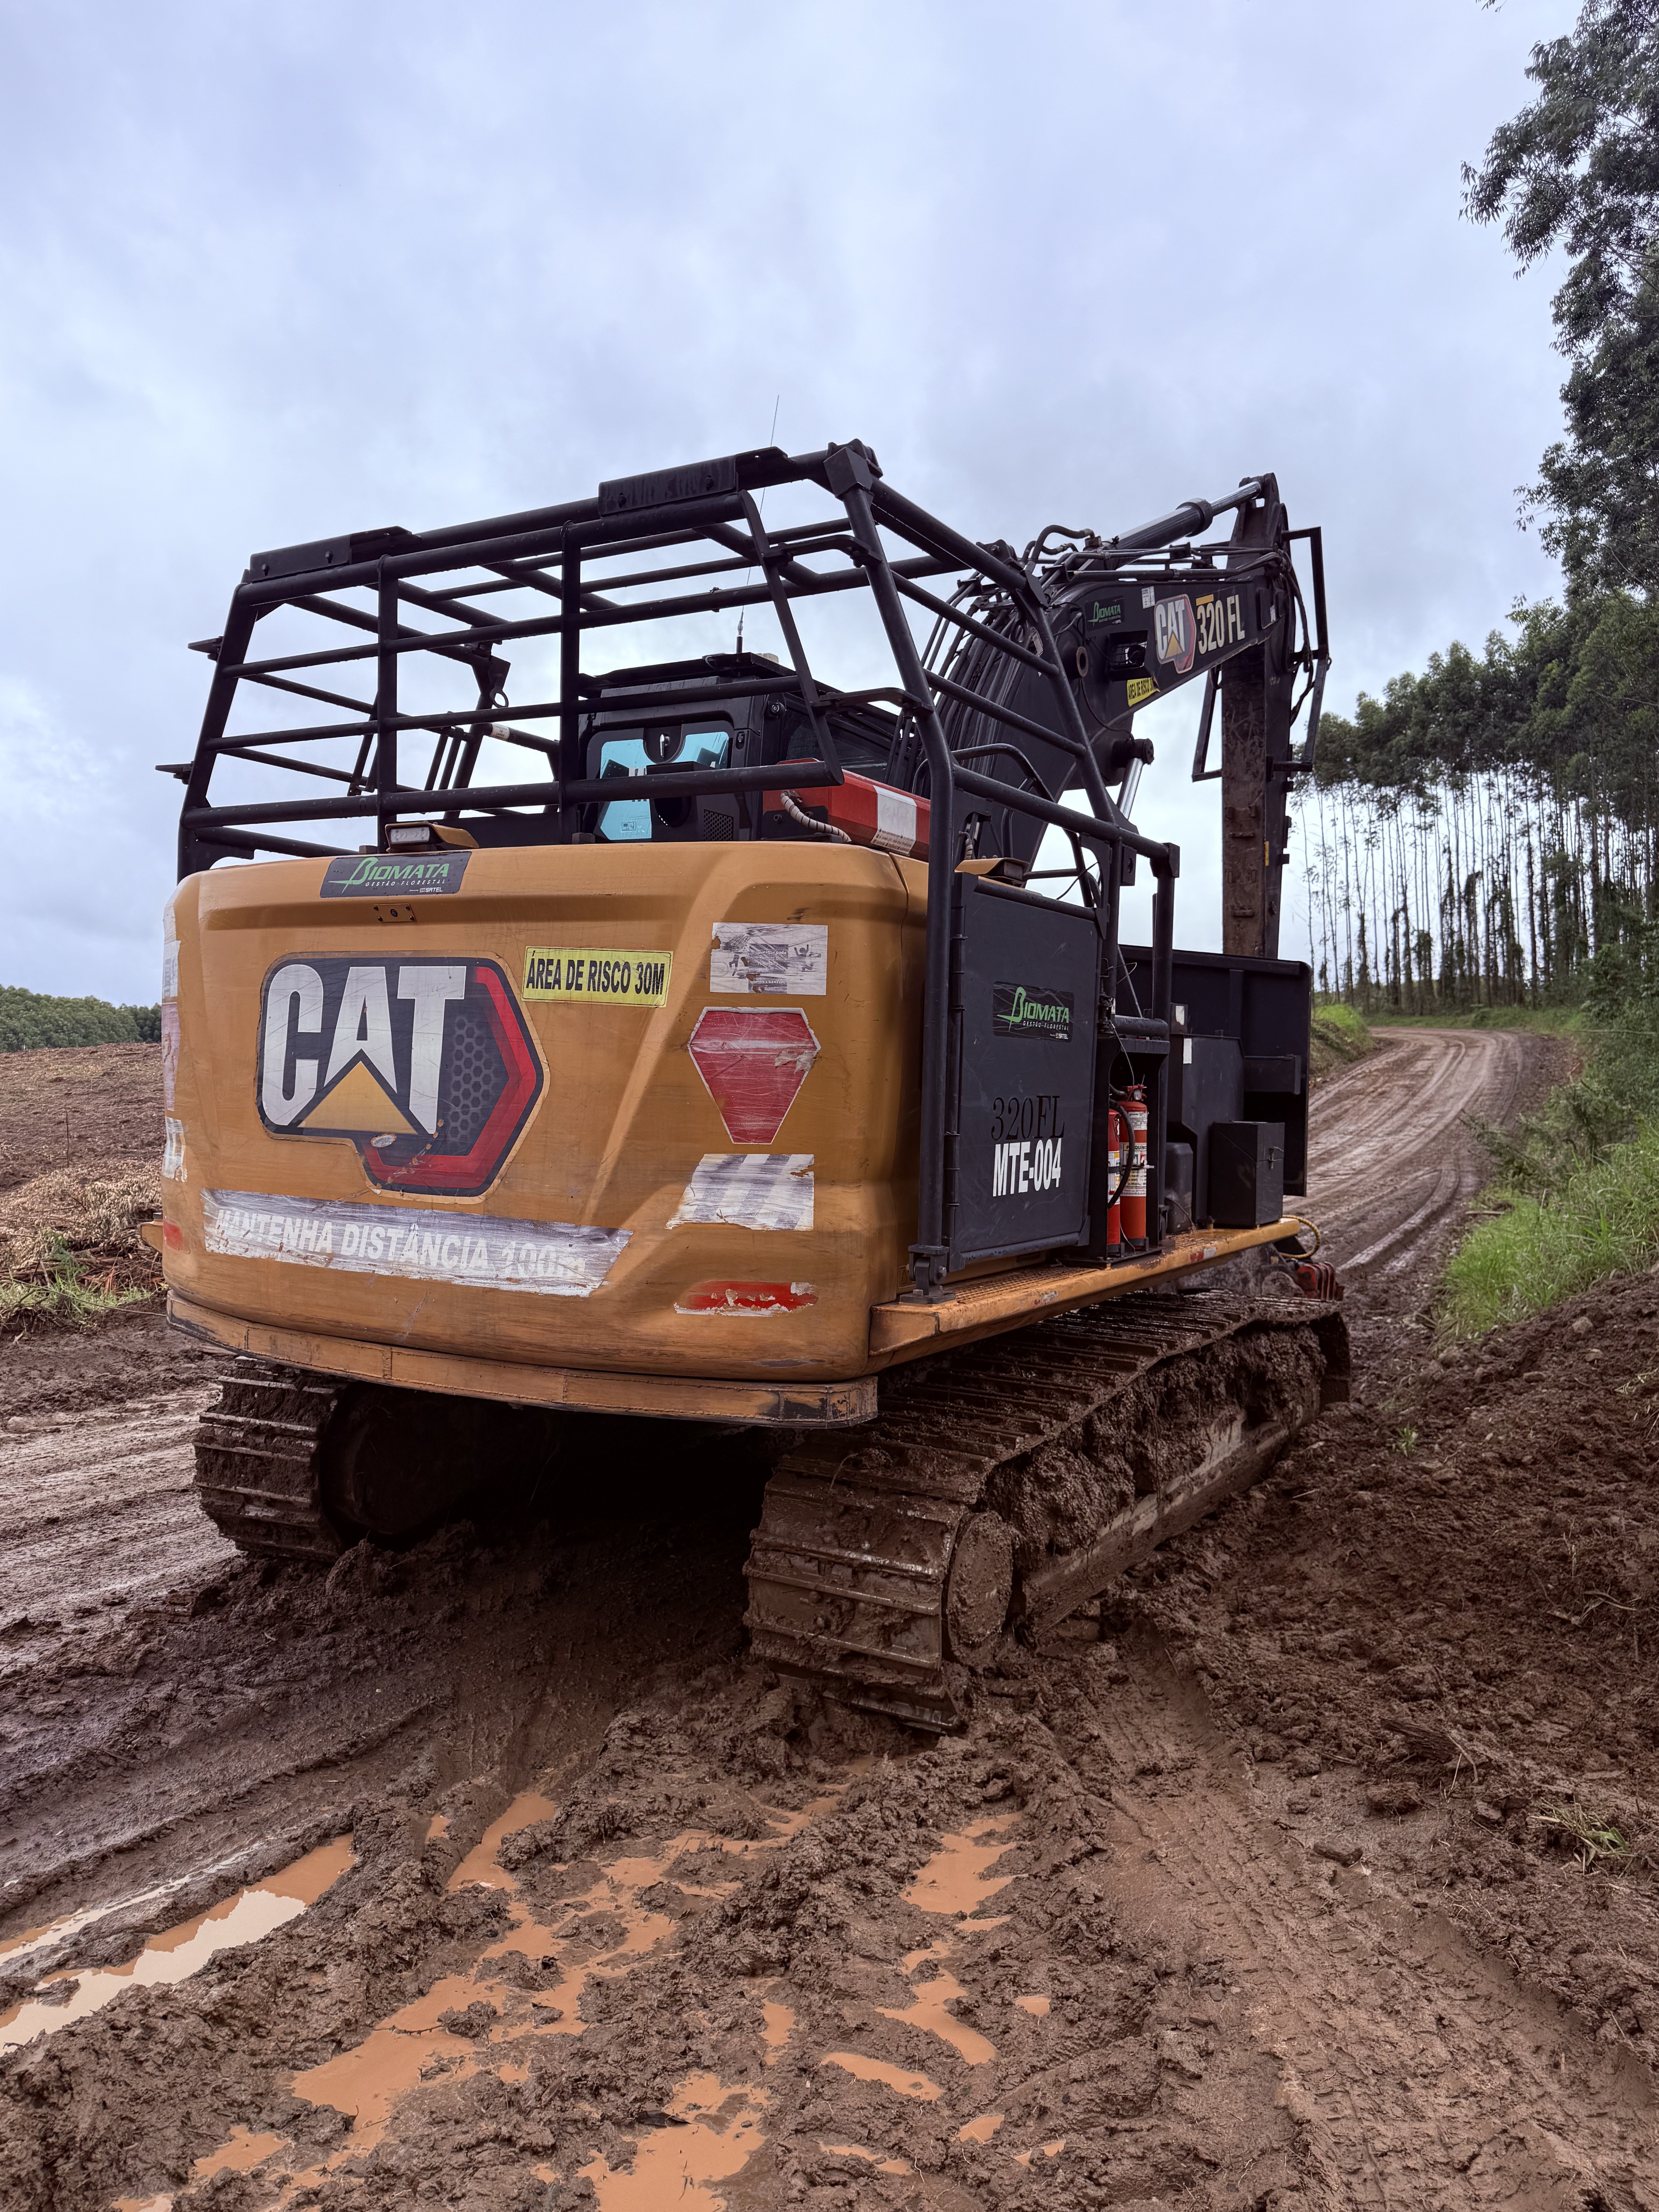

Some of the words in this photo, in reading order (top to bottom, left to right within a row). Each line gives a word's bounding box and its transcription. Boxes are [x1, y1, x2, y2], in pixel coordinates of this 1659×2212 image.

[1087, 601, 1121, 627] BIOMATA
[1156, 599, 1185, 659] CAT
[1197, 600, 1224, 654] 320
[1227, 594, 1245, 644] FL
[329, 857, 450, 893] BIOMATA
[526, 950, 561, 990] ÁREA
[565, 960, 585, 991] DE
[587, 960, 631, 993] RISCO
[635, 962, 665, 995] 30M
[997, 987, 1069, 1032] BIOMATA
[262, 964, 467, 1135] CAT
[991, 1096, 1065, 1141] 320FL
[993, 1138, 1062, 1197] MTE-004
[340, 1223, 488, 1269] DISTÂNCIA
